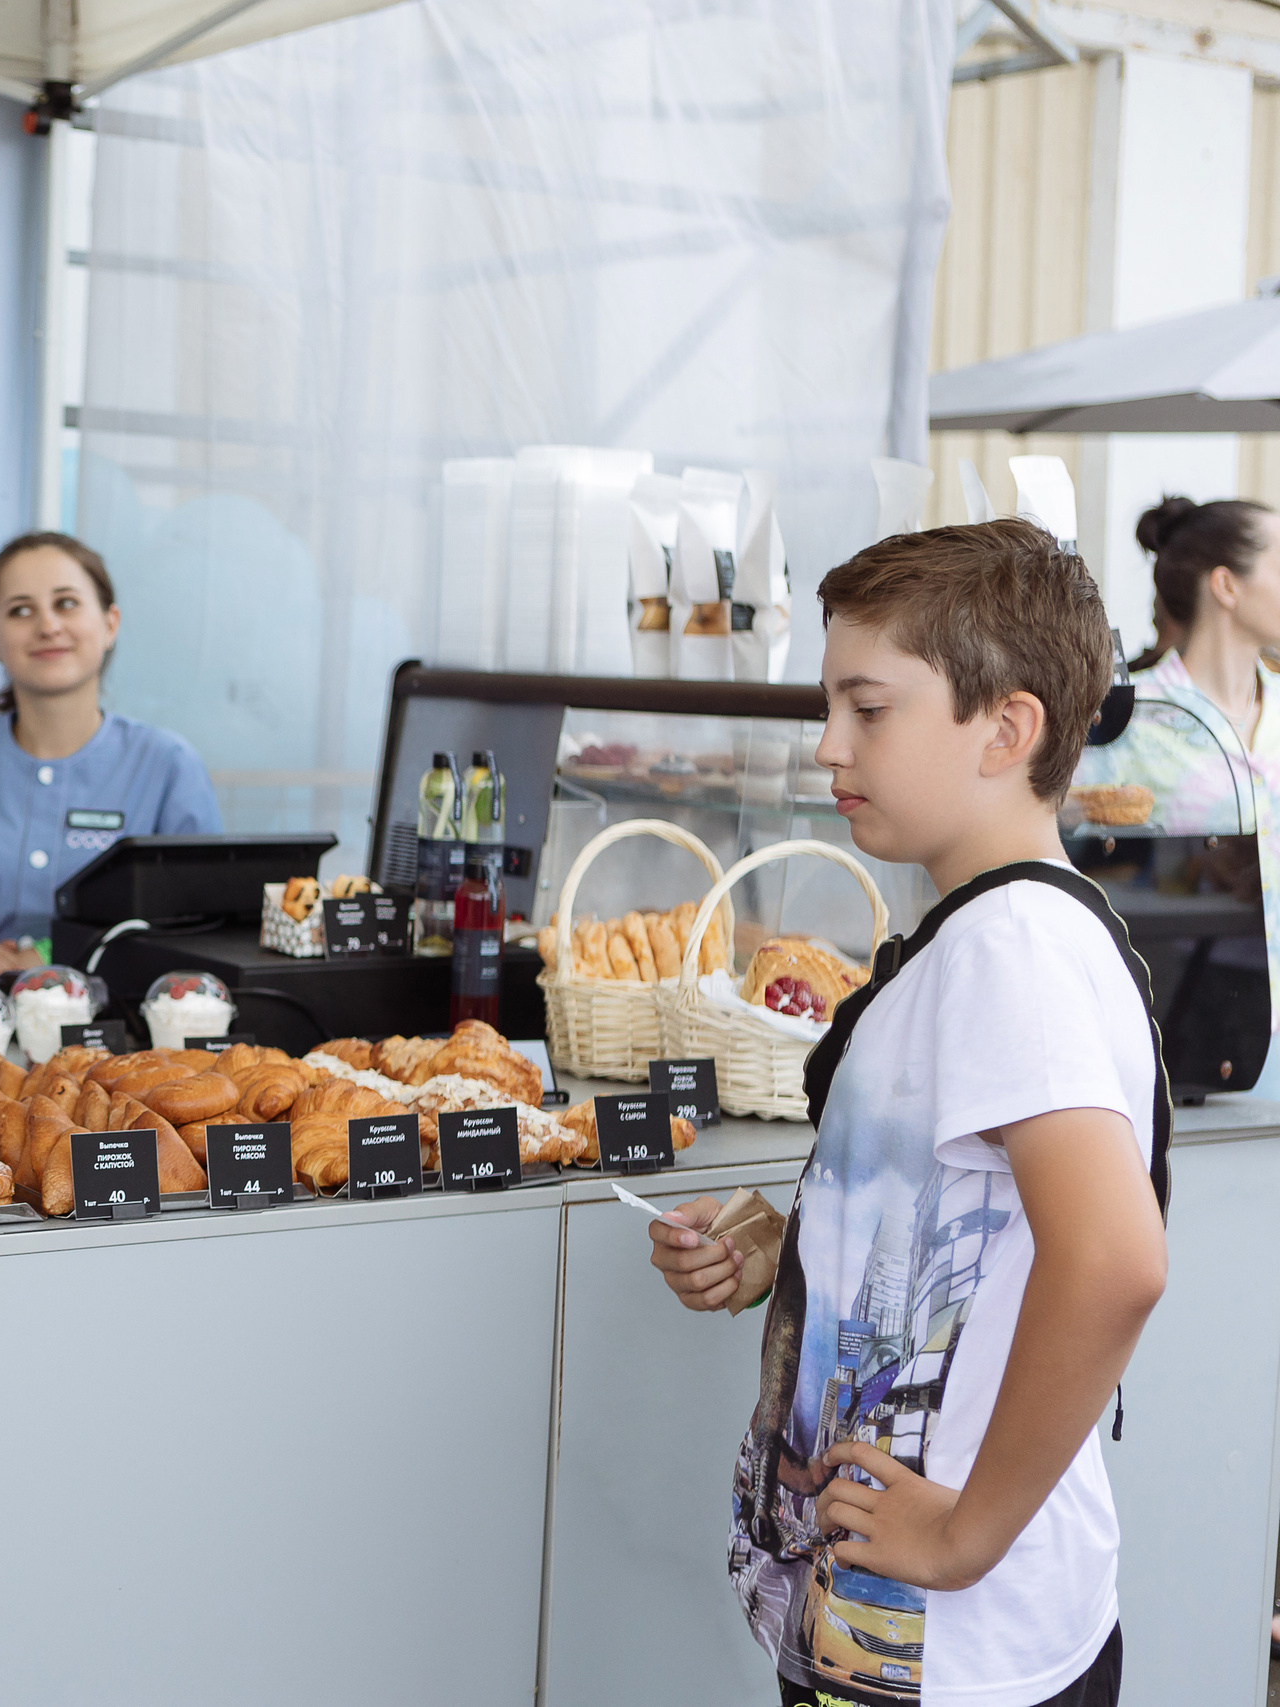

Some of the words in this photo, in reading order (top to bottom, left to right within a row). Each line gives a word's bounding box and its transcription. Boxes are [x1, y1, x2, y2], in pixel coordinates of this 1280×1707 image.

[618, 1102, 647, 1112] Круассан
[676, 1105, 697, 1118] 290
[625, 1112, 647, 1120] СЫРОМ
[463, 1118, 494, 1128] Круассан
[370, 1125, 396, 1134] Круассан
[456, 1126, 502, 1138] МИНДАЛЬНЫЙ
[234, 1132, 264, 1140] Выпечка
[362, 1133, 406, 1146] КЛАССИЧЕСКИЙ
[99, 1142, 128, 1150] Выпечка
[232, 1144, 266, 1152] ПИРОЖОК
[240, 1152, 265, 1160] МЯСОМ
[627, 1145, 648, 1159] 150
[98, 1153, 132, 1162] ПИРОЖОК
[100, 1160, 134, 1170] КАПУСТОЙ
[472, 1162, 494, 1176] 160
[374, 1170, 396, 1184] 100
[244, 1180, 260, 1193] 44
[108, 1190, 126, 1203] 40
